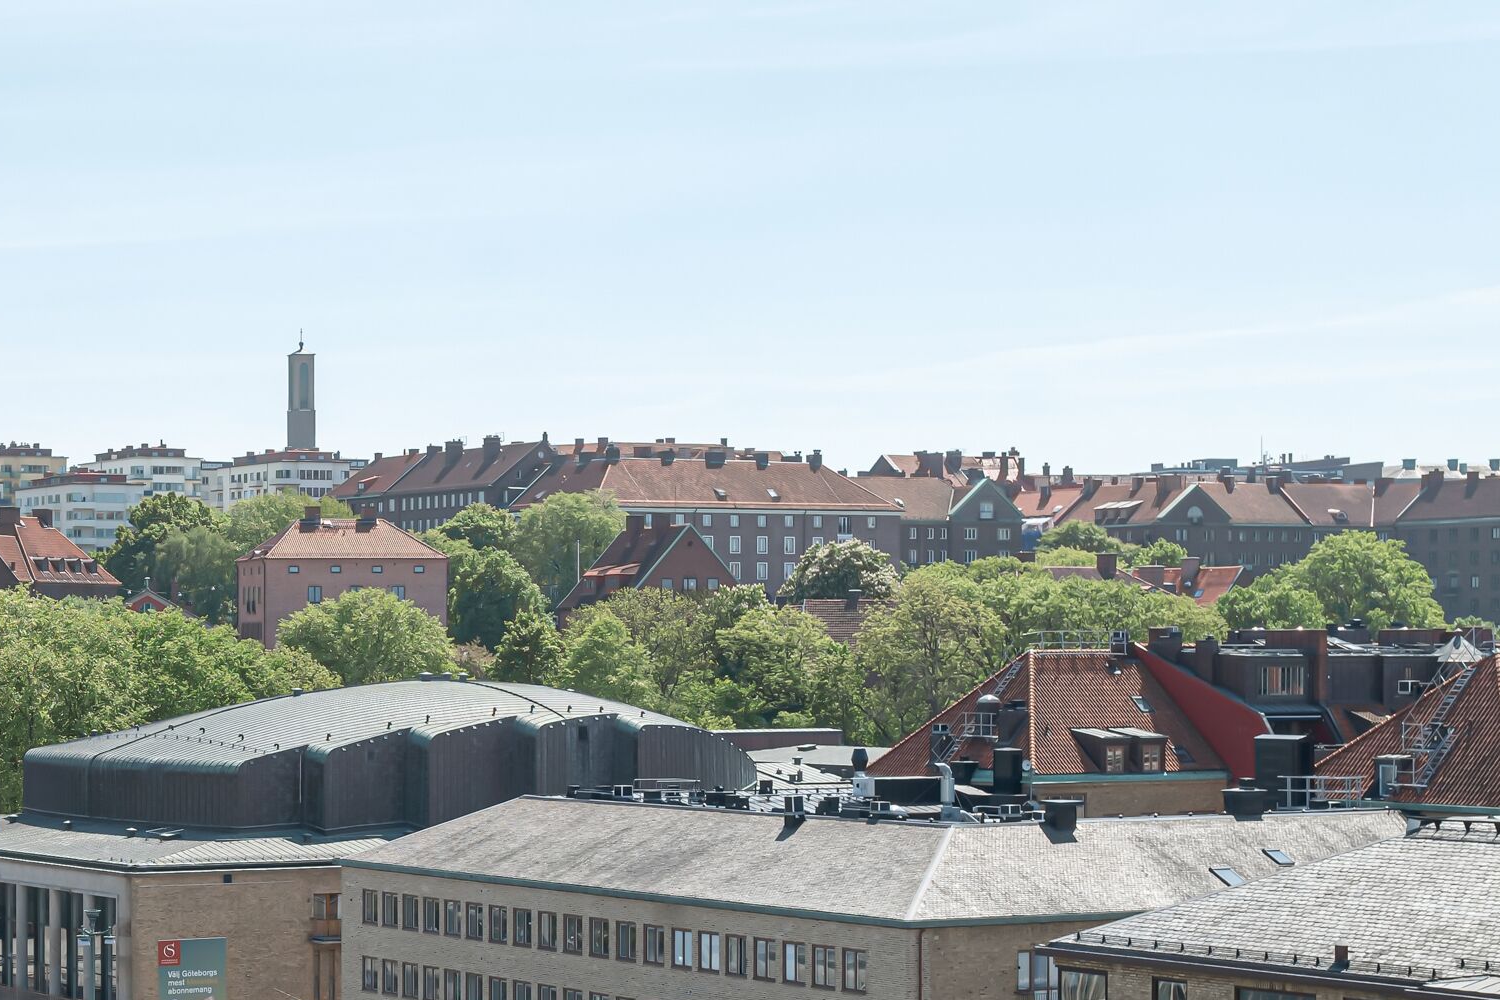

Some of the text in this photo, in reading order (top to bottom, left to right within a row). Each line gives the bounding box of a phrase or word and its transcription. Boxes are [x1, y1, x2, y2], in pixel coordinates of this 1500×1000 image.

[182, 970, 218, 978] Göteborgs
[167, 979, 185, 987] mest
[167, 986, 213, 995] abonnemang
